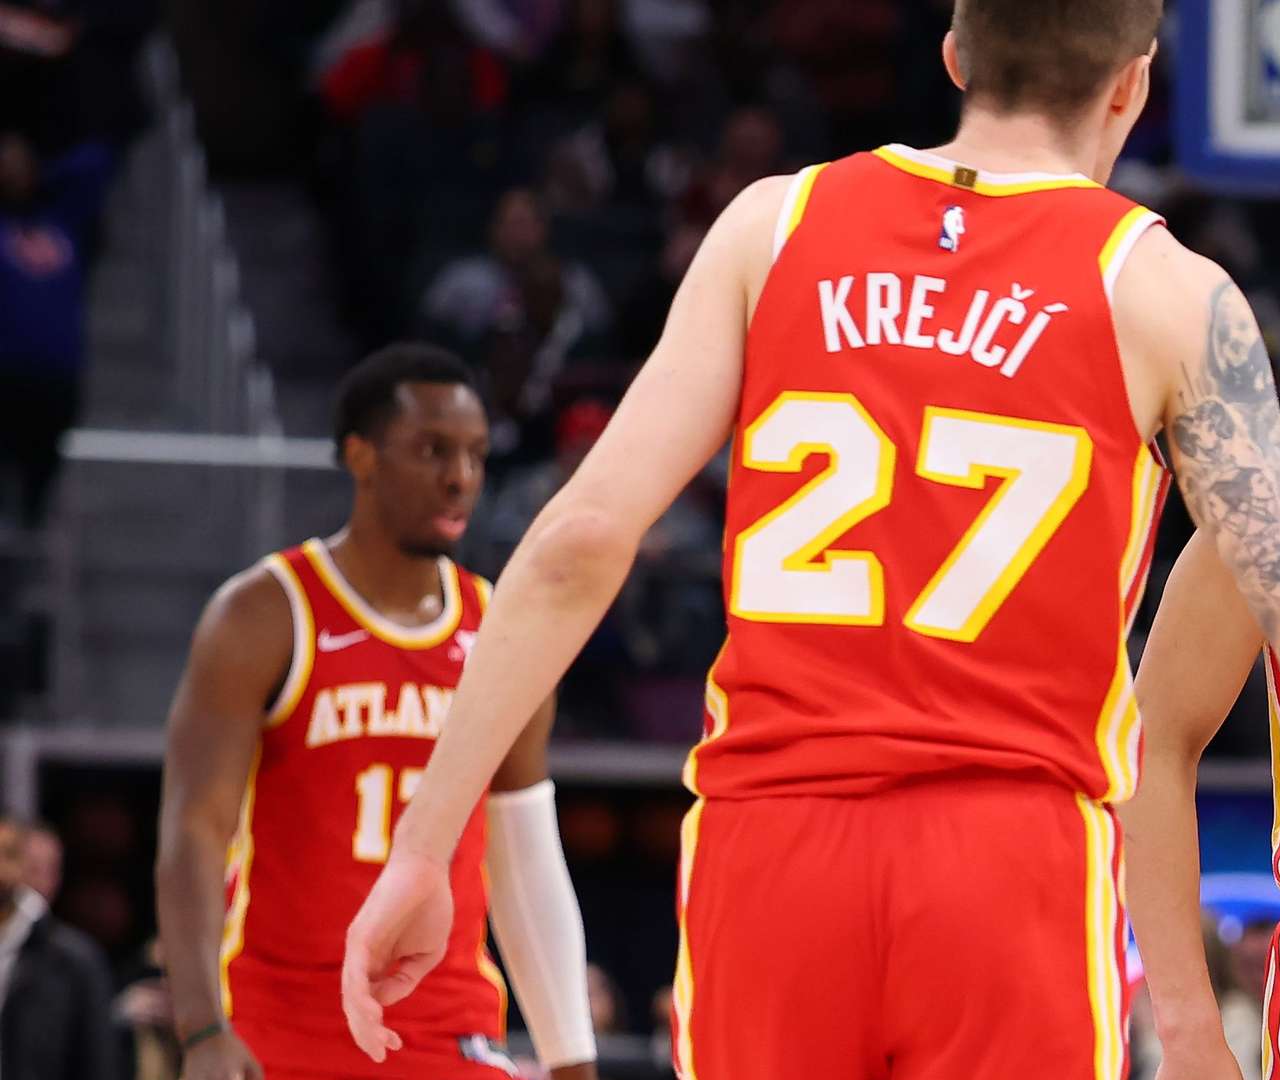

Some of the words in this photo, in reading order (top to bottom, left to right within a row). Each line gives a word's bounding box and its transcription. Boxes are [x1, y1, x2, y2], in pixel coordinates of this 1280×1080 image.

[818, 272, 1070, 378] KREJČÍ
[729, 390, 1094, 643] 27
[352, 762, 426, 864] 1
